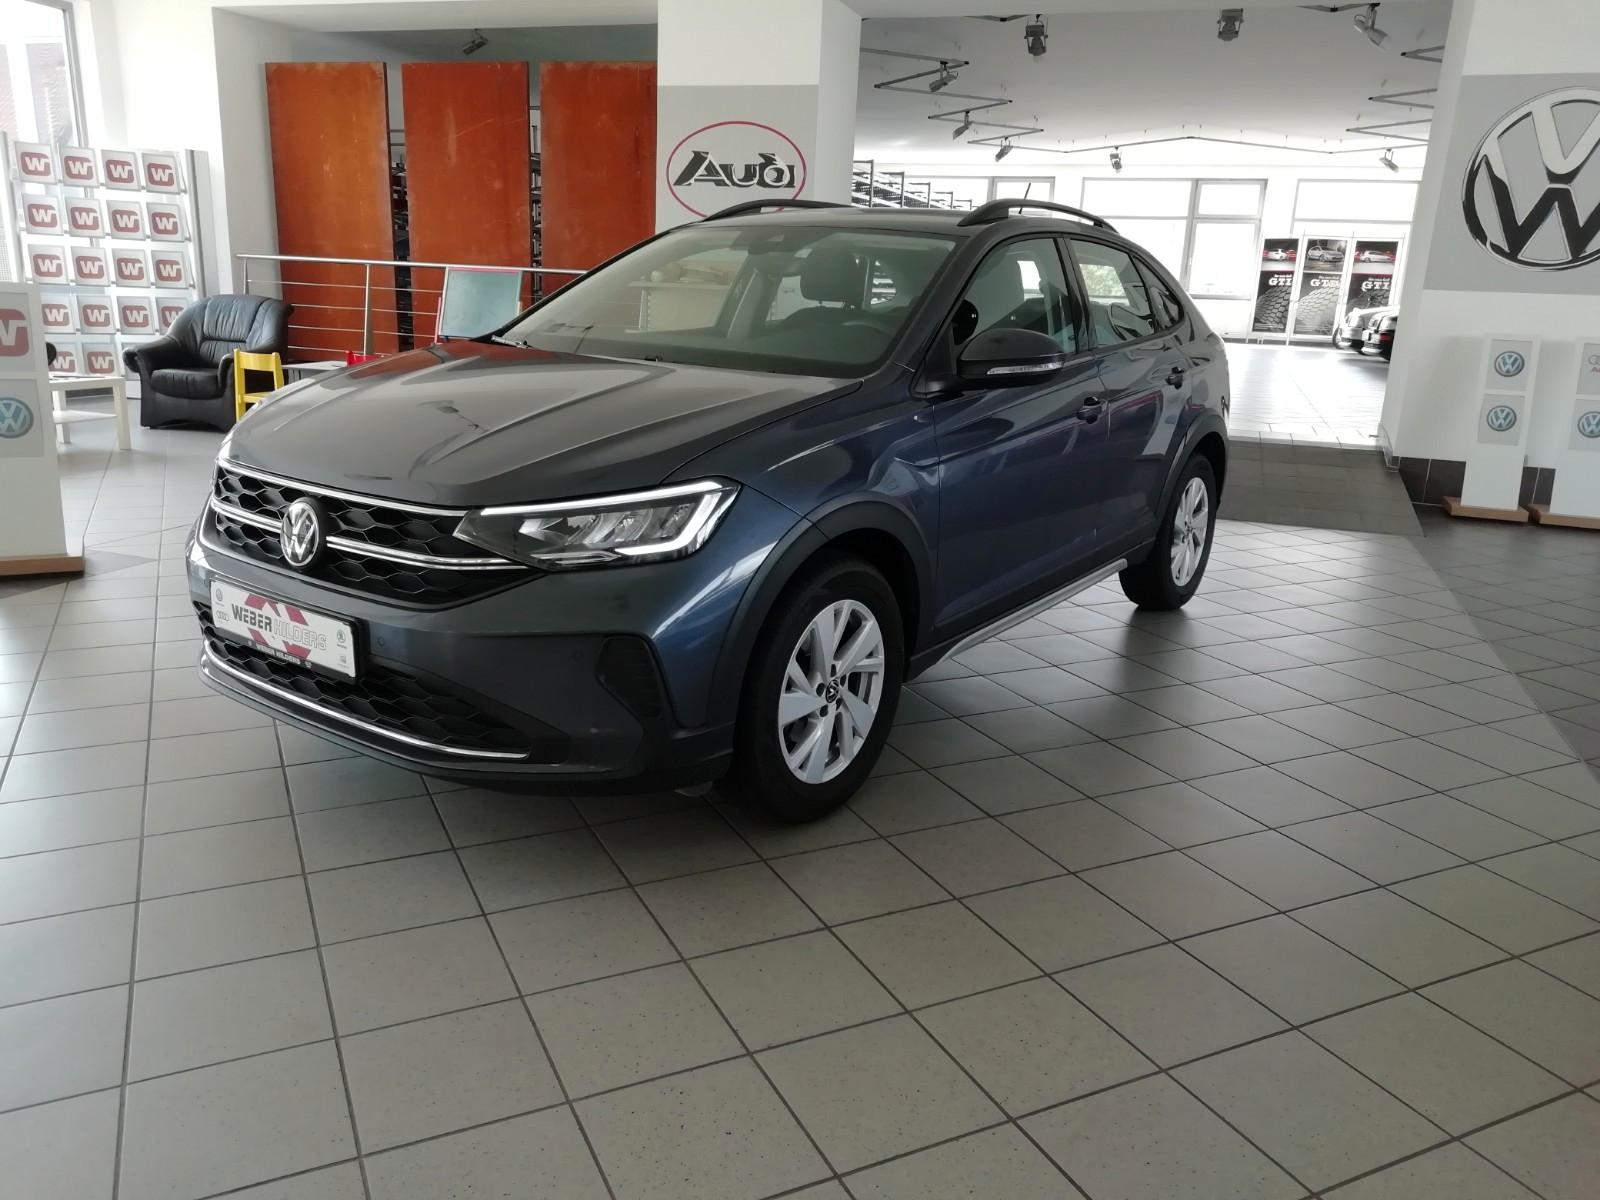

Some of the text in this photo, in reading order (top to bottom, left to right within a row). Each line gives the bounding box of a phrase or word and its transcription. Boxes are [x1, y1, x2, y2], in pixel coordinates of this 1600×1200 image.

[673, 150, 796, 189] Audi
[1268, 277, 1293, 286] GTI
[281, 502, 319, 566] VW
[231, 603, 273, 633] WEBER
[273, 618, 328, 651] HILDERS
